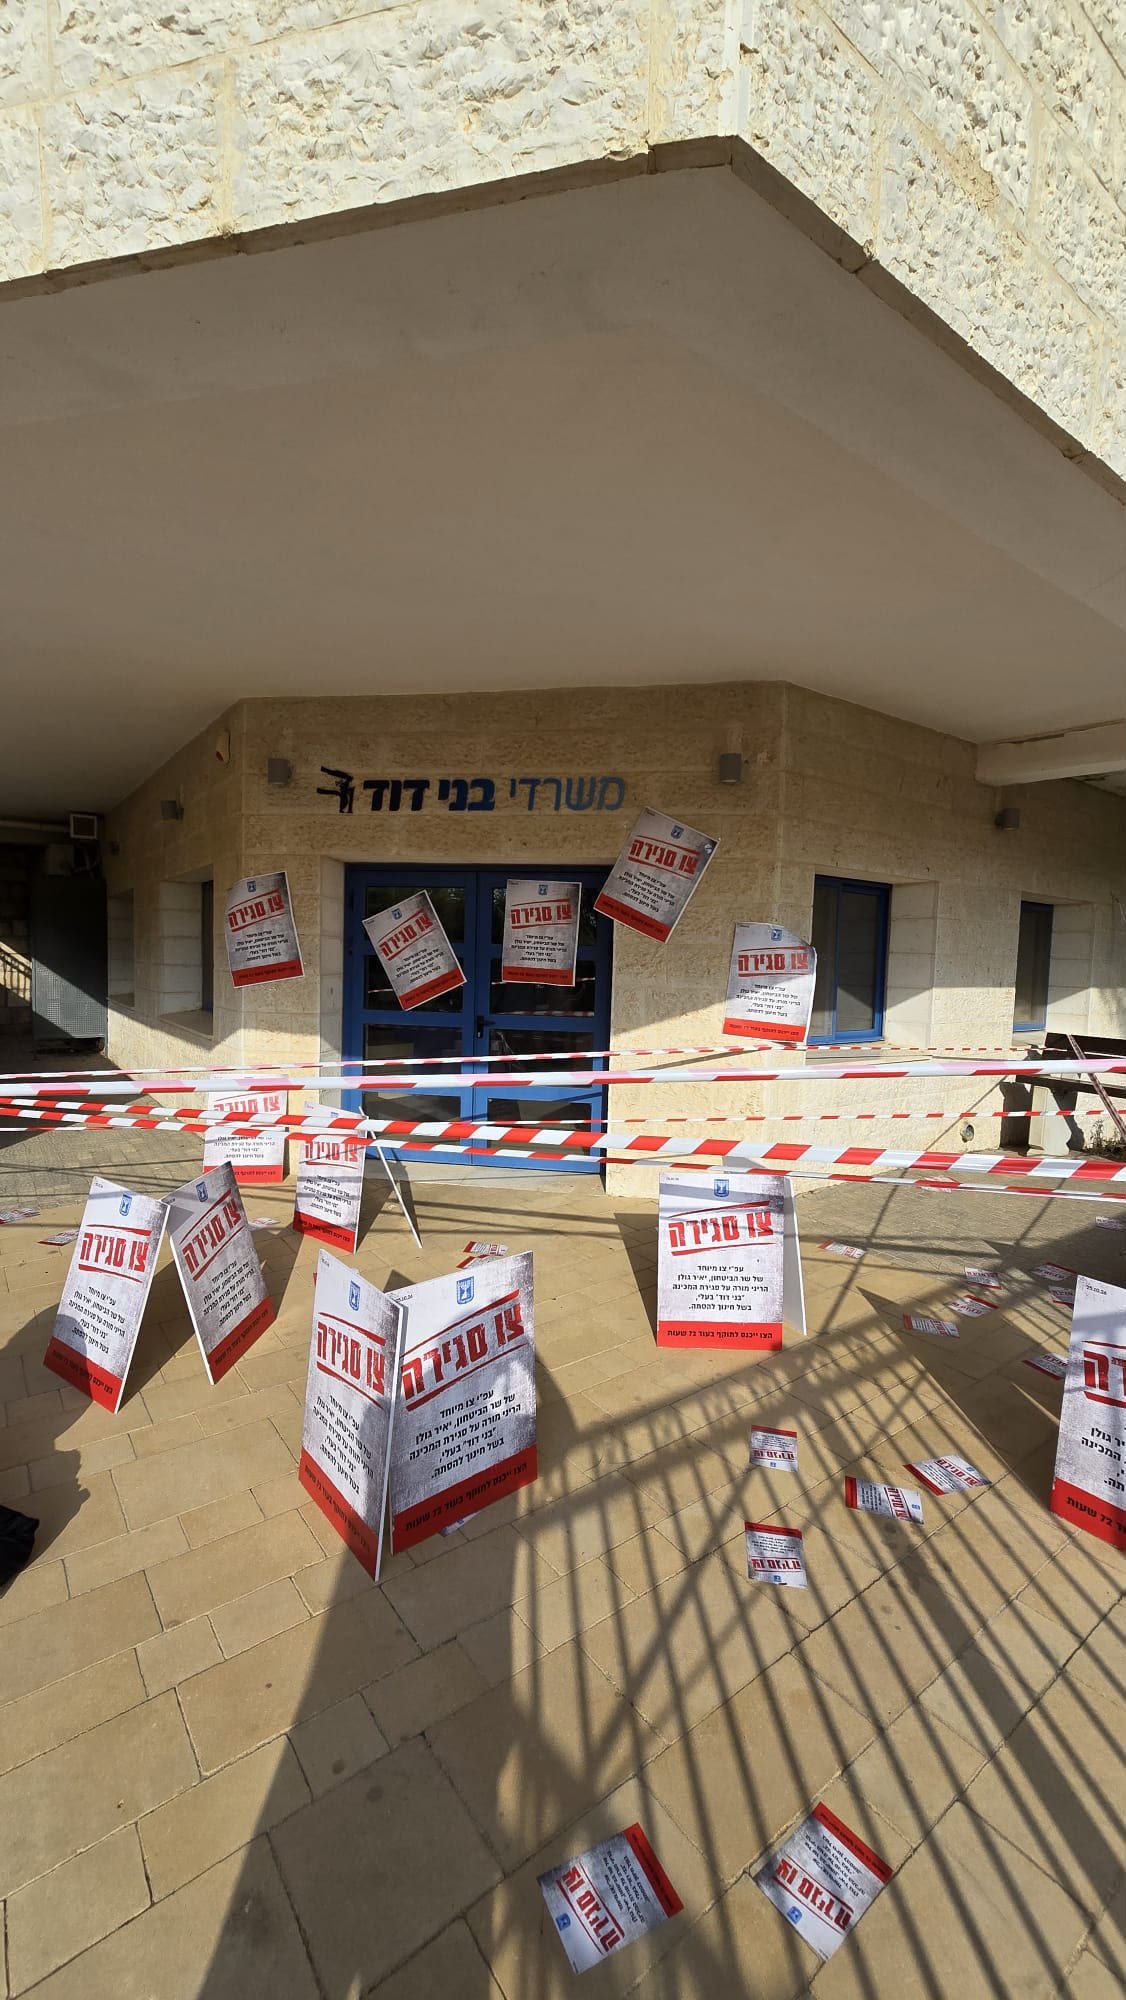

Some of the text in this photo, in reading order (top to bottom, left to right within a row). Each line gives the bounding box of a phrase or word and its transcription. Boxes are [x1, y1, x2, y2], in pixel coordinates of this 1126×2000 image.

[363, 776, 625, 812] משרדי בני דוד
[630, 839, 699, 874] צו סגירה
[227, 894, 284, 928] צו סגירה
[511, 905, 572, 924] צו סגירה
[379, 913, 433, 957] צו סגירה
[738, 953, 808, 971] צו סגירה
[263, 1095, 280, 1112] צו
[182, 1197, 241, 1274] צו סגירה
[668, 1211, 773, 1248] צו סגירה
[80, 1233, 149, 1272] צו סגירה
[317, 1322, 361, 1380] סגירה
[401, 1303, 524, 1400] צו סגירה
[366, 1348, 385, 1395] צו
[416, 1392, 515, 1445] של שר הביטחון, יאיר גולן
[440, 1389, 494, 1419] עפ"י צו מיוחד
[410, 1403, 521, 1460] הריני מורה על סגירת המכינה
[439, 1427, 496, 1463] "בני דוד" בעלי,
[1082, 1437, 1121, 1461] המכינה
[1091, 1428, 1111, 1443] גולן
[431, 1436, 504, 1479] בשל חינוך להסתה.
[1066, 1496, 1113, 1527] 72 שעות
[561, 1866, 620, 1952] צו סגירה
[775, 1858, 798, 1885] צו
[797, 1877, 851, 1931] סגירה
